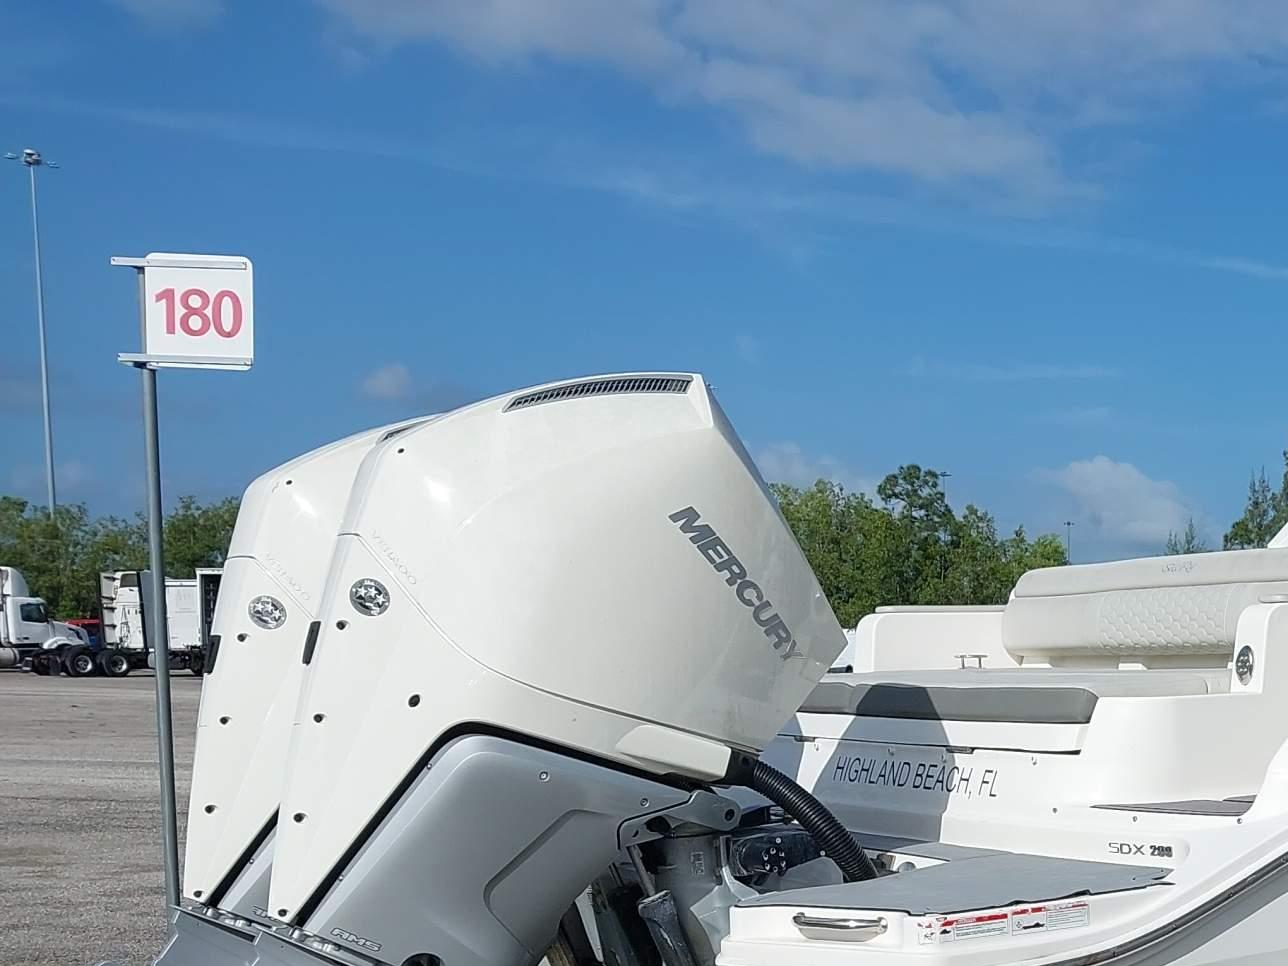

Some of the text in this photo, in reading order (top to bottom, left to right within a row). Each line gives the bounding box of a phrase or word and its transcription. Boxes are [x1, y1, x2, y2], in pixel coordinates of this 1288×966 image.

[154, 288, 243, 338] 180
[668, 505, 805, 662] MERCURY
[833, 755, 999, 800] HIGHLAND BEACH, FL
[1108, 842, 1146, 856] SDX
[330, 927, 382, 952] AMS
